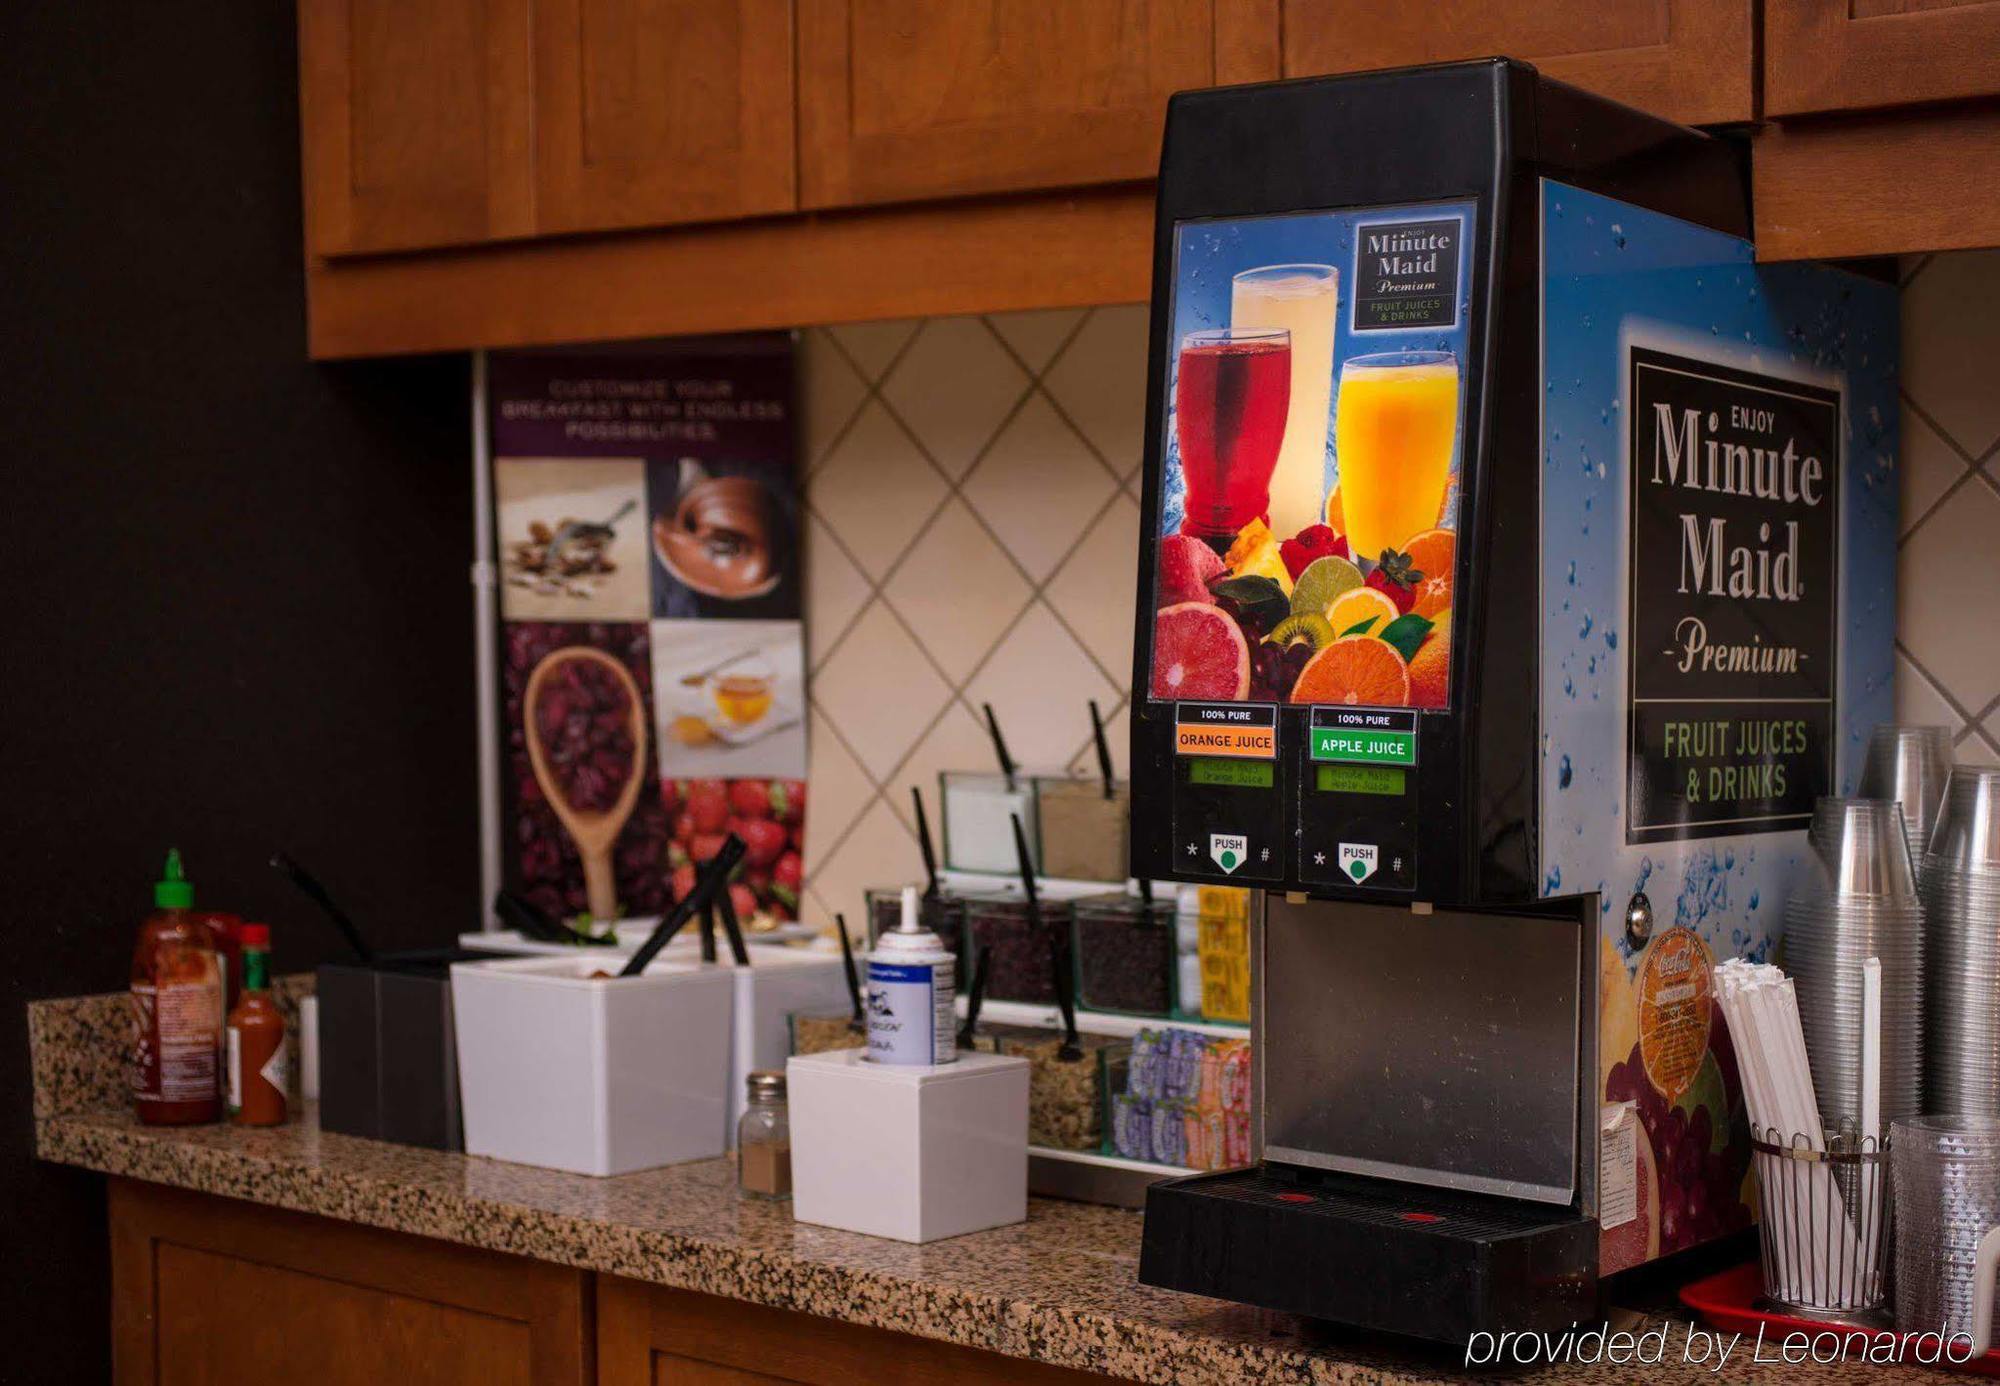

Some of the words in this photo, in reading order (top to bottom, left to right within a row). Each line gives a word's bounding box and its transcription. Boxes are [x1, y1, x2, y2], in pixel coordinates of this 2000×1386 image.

[1368, 234, 1450, 254] Minute
[1378, 253, 1437, 276] Maid
[1371, 302, 1400, 312] FRUIT
[1405, 299, 1441, 311] JUICES
[1381, 313, 1389, 321] &
[1391, 309, 1429, 321] DRINKS
[1731, 405, 1775, 434] ENJOY
[1651, 403, 1824, 507] Minute
[1677, 514, 1800, 601] Maid
[1201, 710, 1225, 719] 100%
[1228, 711, 1251, 720] PURE
[1338, 714, 1363, 724] 100%
[1366, 715, 1390, 725] PURE
[1180, 734, 1231, 746] ORANGE
[1235, 736, 1271, 748] JUICE
[1321, 739, 1362, 752] APPLE
[1367, 741, 1405, 755] JUICE
[1664, 721, 1729, 759] FRUIT
[1736, 720, 1807, 755] JUICES
[1686, 771, 1701, 803] &
[1709, 763, 1786, 802] DRINKS
[1215, 838, 1242, 849] PUSH
[1343, 847, 1373, 859] PUSH
